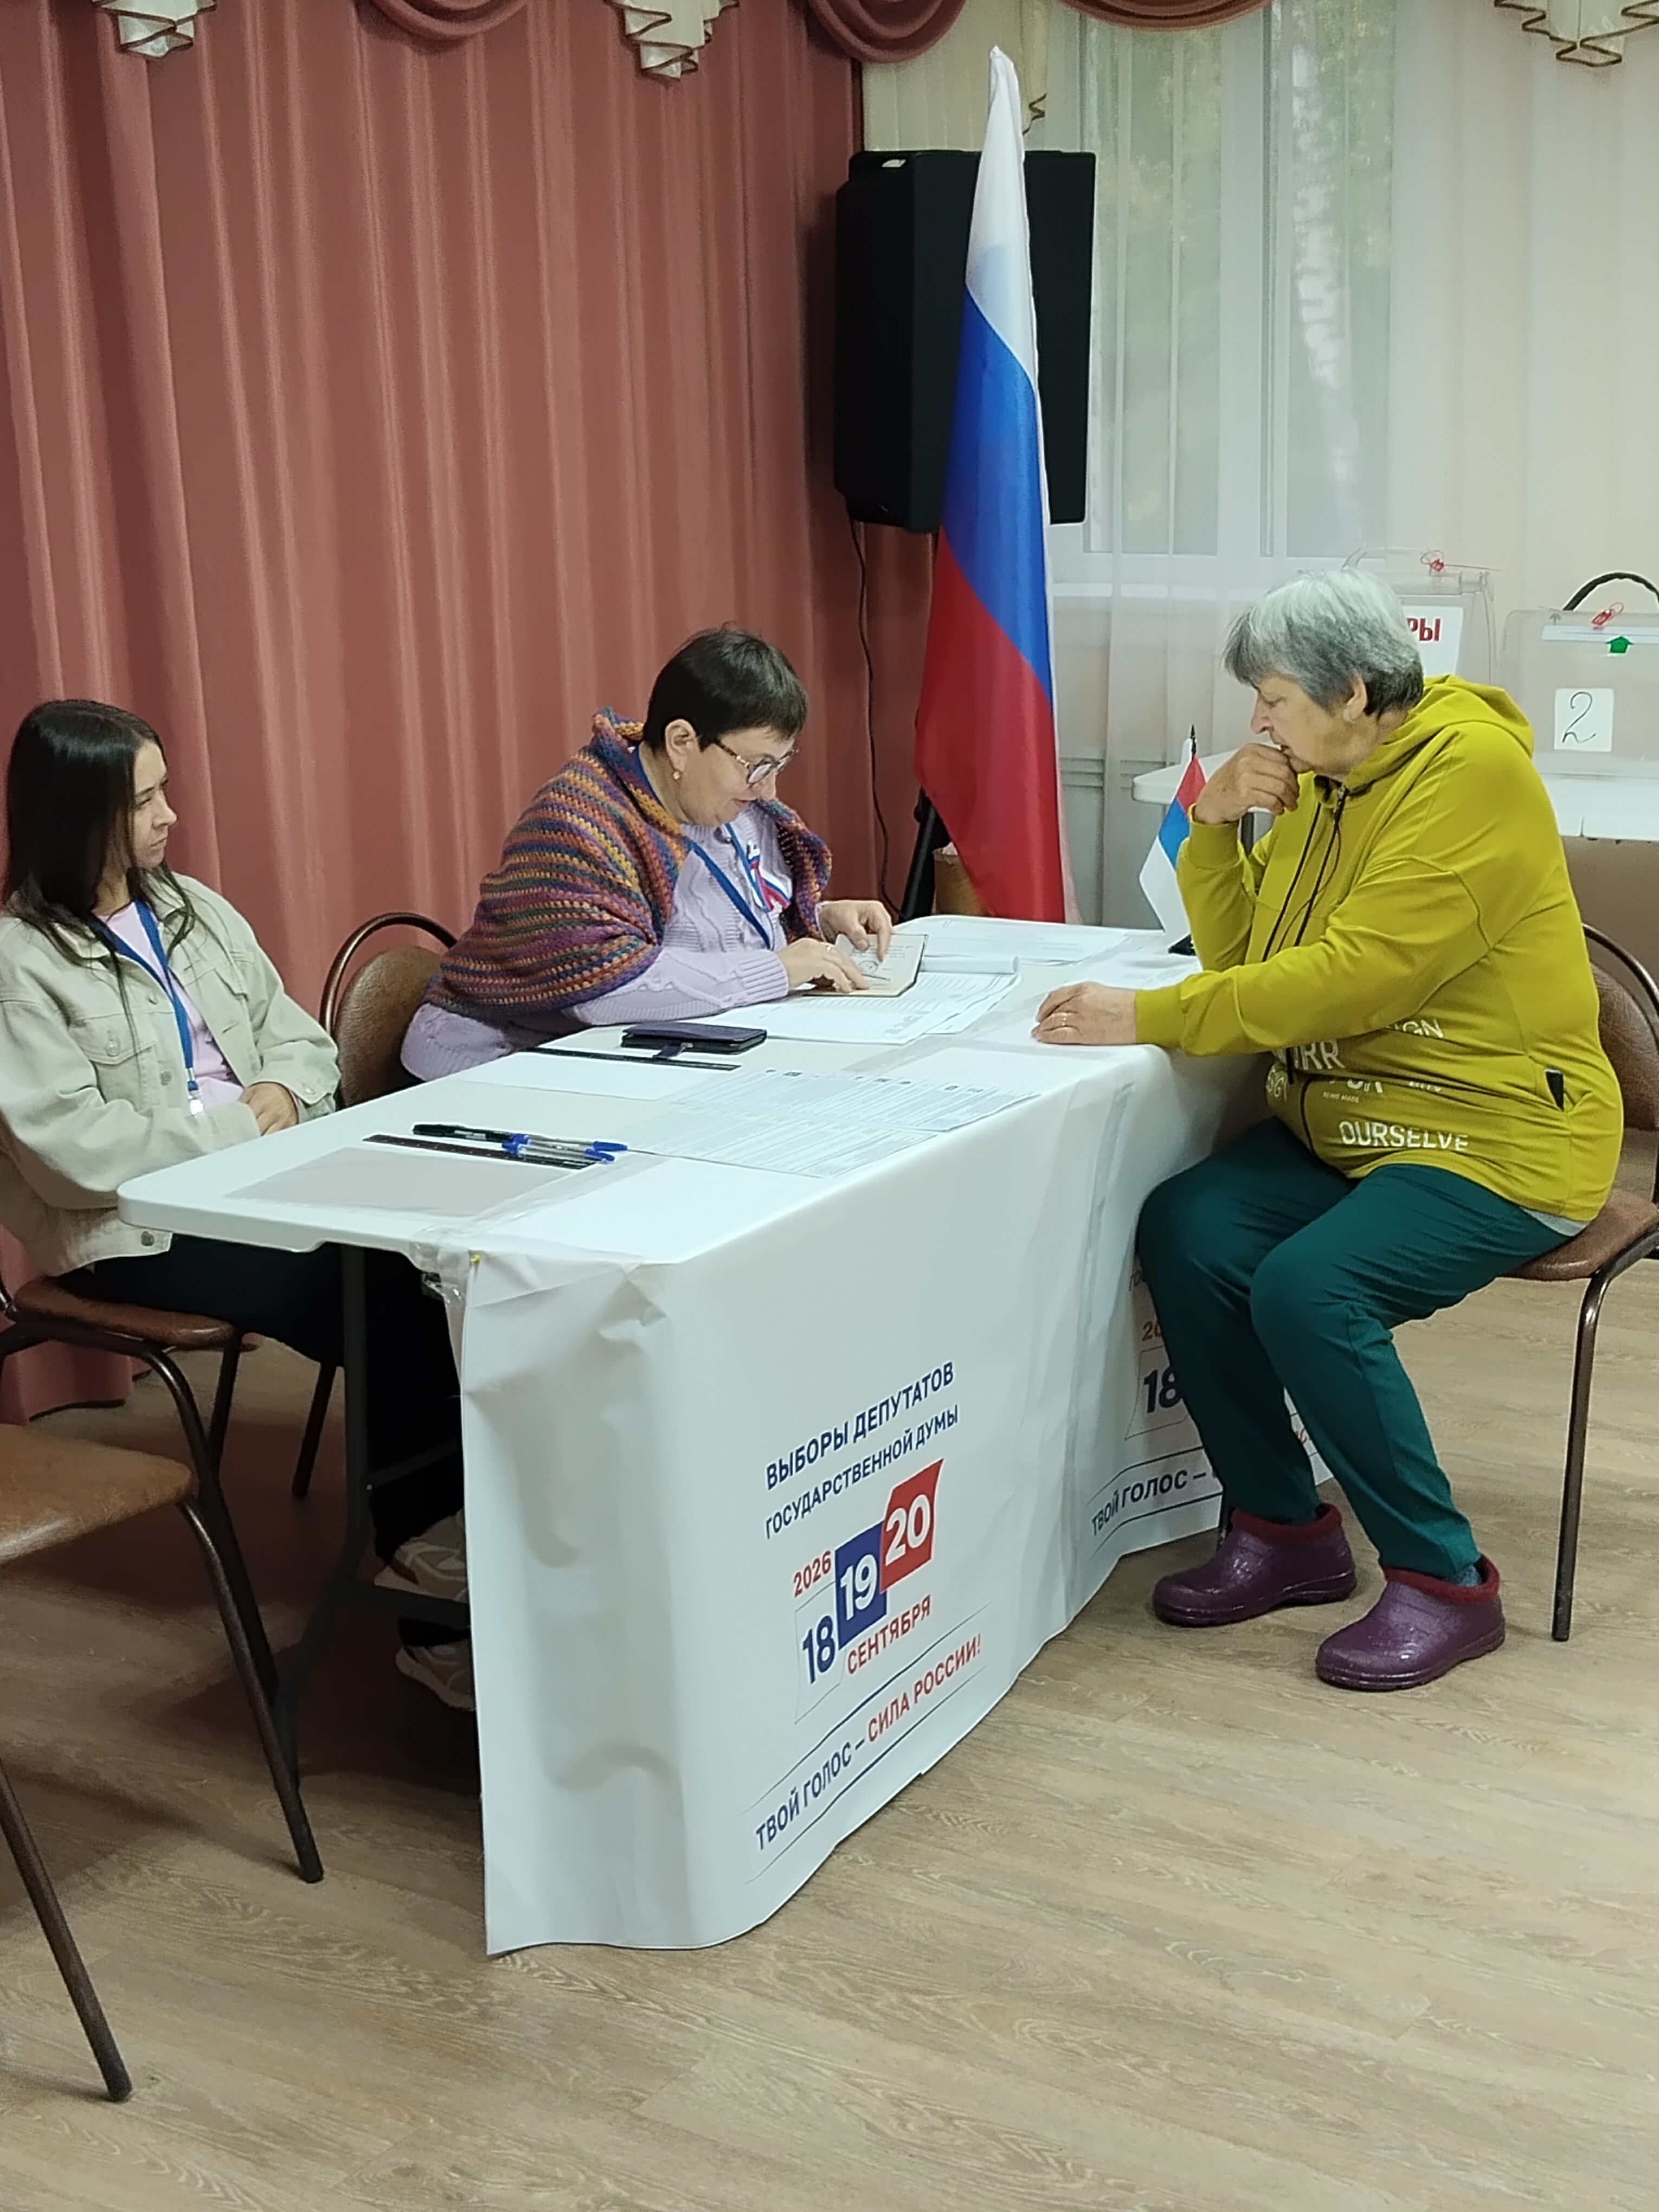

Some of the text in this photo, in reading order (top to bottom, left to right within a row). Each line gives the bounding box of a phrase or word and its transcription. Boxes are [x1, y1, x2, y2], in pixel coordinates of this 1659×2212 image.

[1562, 691, 1597, 743] 2
[1339, 1120, 1469, 1151] OURSELVE
[766, 1361, 953, 1490] ВЫБОРЫ ДЕПУТАТОВ
[1143, 1366, 1183, 1413] 18
[766, 1405, 959, 1539] ГОСУДАРСТВЕННОЙ ДУМЫ
[1092, 1489, 1119, 1536] ТВОЙ
[1121, 1470, 1188, 1508] ГОЛОС
[793, 1551, 832, 1598] 2026
[802, 1494, 931, 1684] 18 19 20
[847, 1594, 931, 1675] СЕНТЯБРЯ
[755, 1786, 800, 1850] ТВОЙ
[802, 1742, 852, 1809] ГОЛОС
[868, 1692, 910, 1742] СИЛА
[914, 1633, 981, 1703] РОССИИ!
